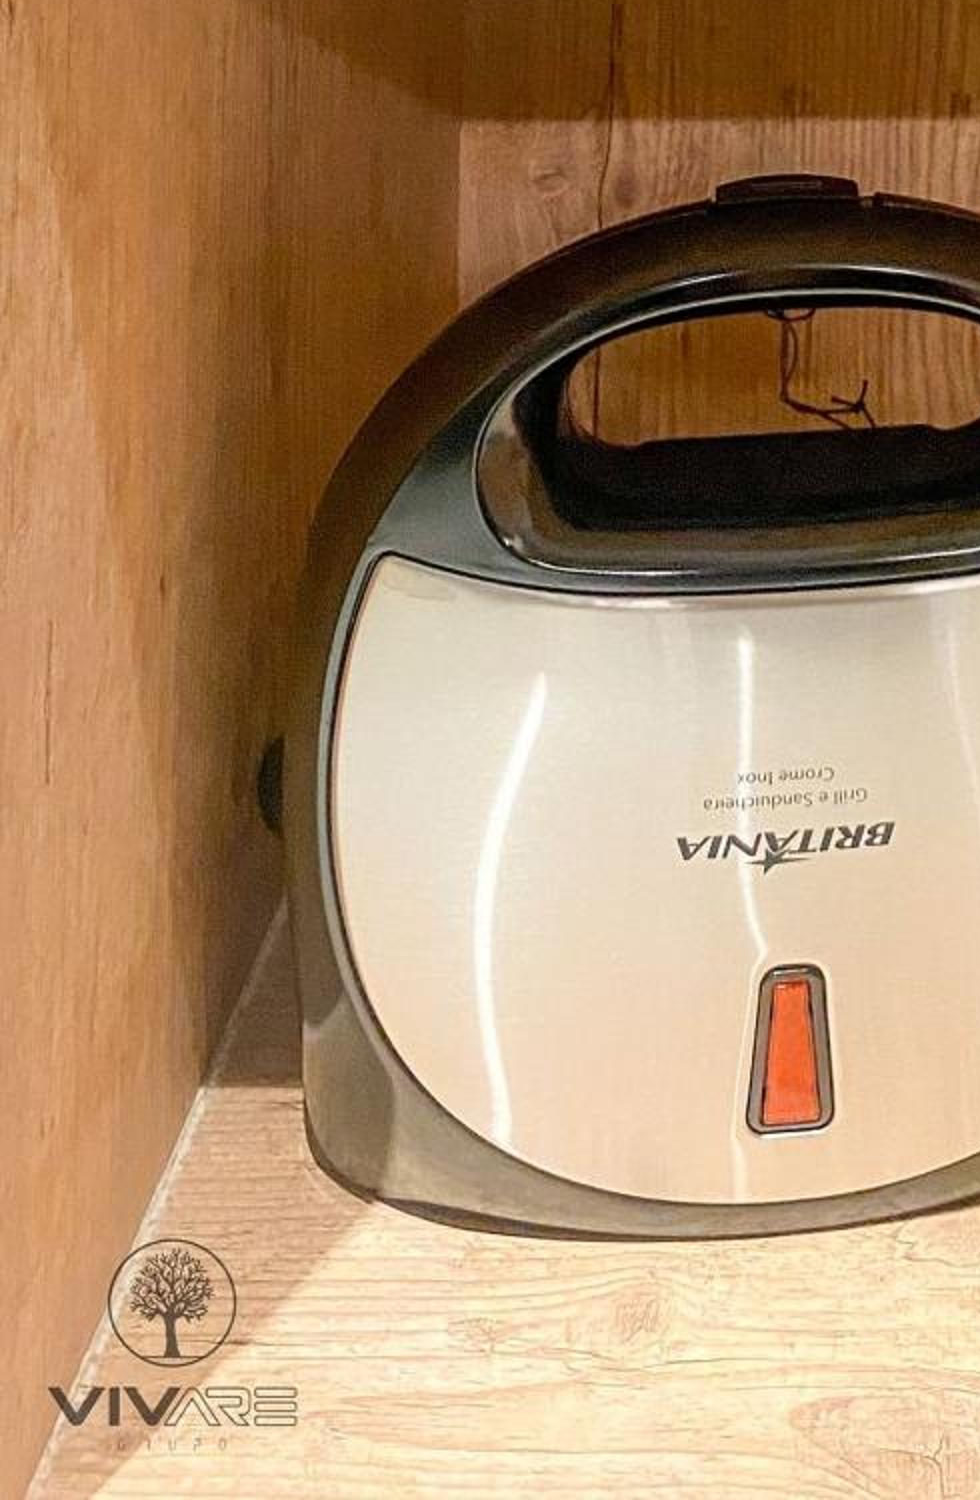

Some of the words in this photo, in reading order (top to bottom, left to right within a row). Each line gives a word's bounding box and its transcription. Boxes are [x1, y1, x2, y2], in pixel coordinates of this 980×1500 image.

[737, 770, 774, 786] Inox
[778, 767, 835, 783] Crome
[703, 790, 813, 811] Sanduicheira
[819, 790, 829, 802] e
[834, 787, 868, 804] Grill
